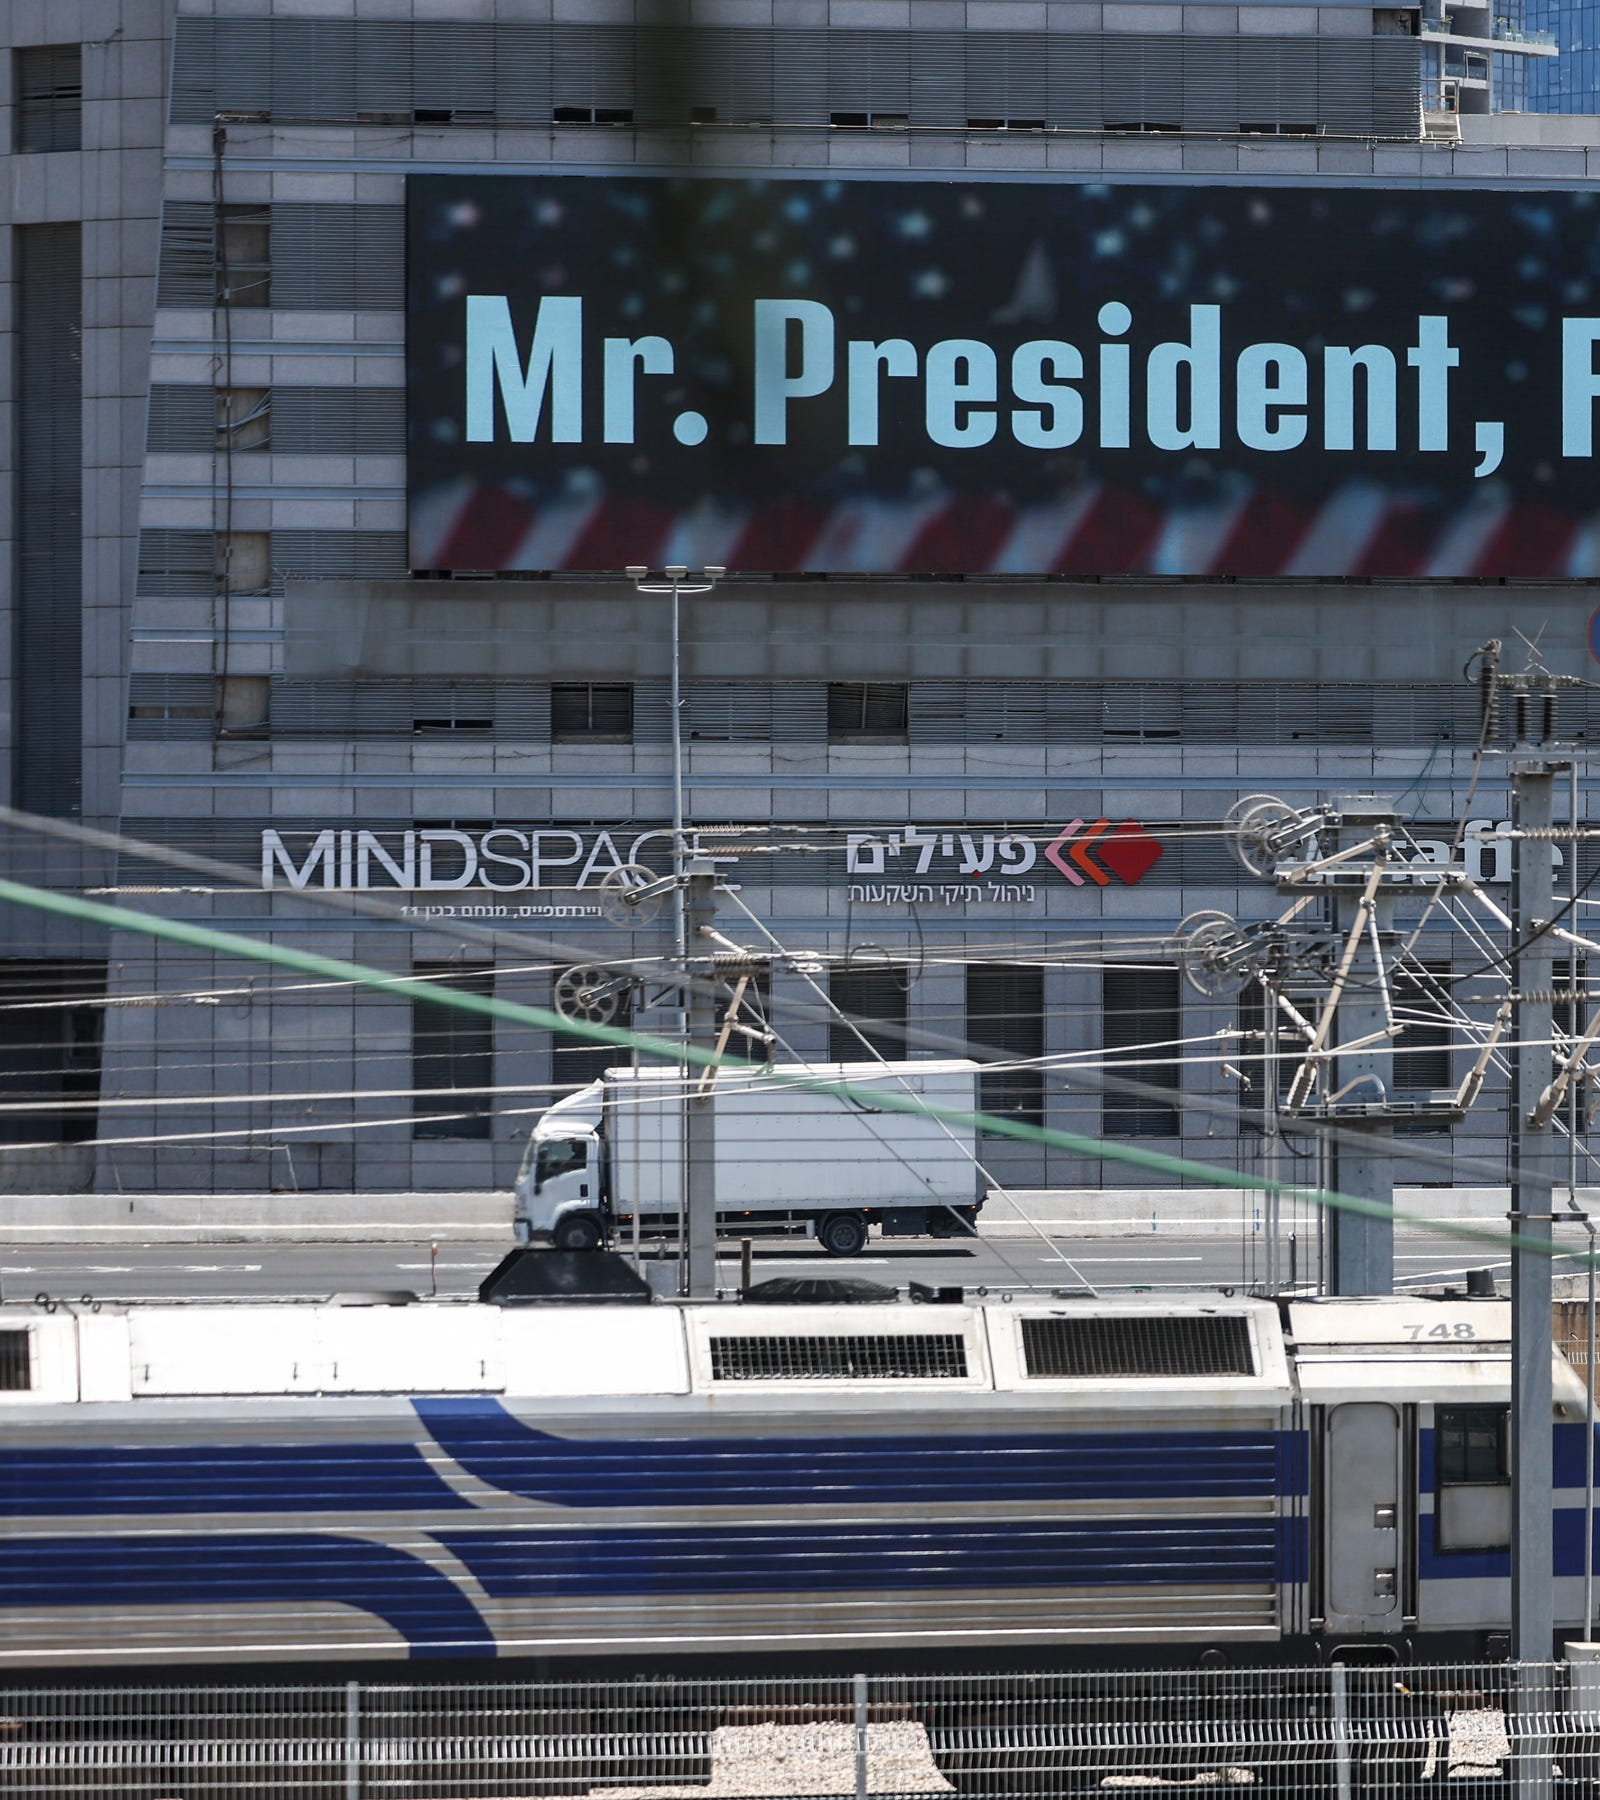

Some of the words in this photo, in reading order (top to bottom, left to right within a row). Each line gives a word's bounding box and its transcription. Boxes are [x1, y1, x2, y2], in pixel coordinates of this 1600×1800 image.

[465, 294, 709, 445] Mr.
[753, 297, 1505, 479] President,
[847, 825, 1037, 876] פעילים
[848, 884, 934, 906] השקעות
[940, 884, 982, 906] תיקי
[987, 881, 1035, 902] ניהול
[424, 905, 457, 921] בגין
[460, 905, 508, 918] מנחם
[1402, 1322, 1476, 1340] 748
